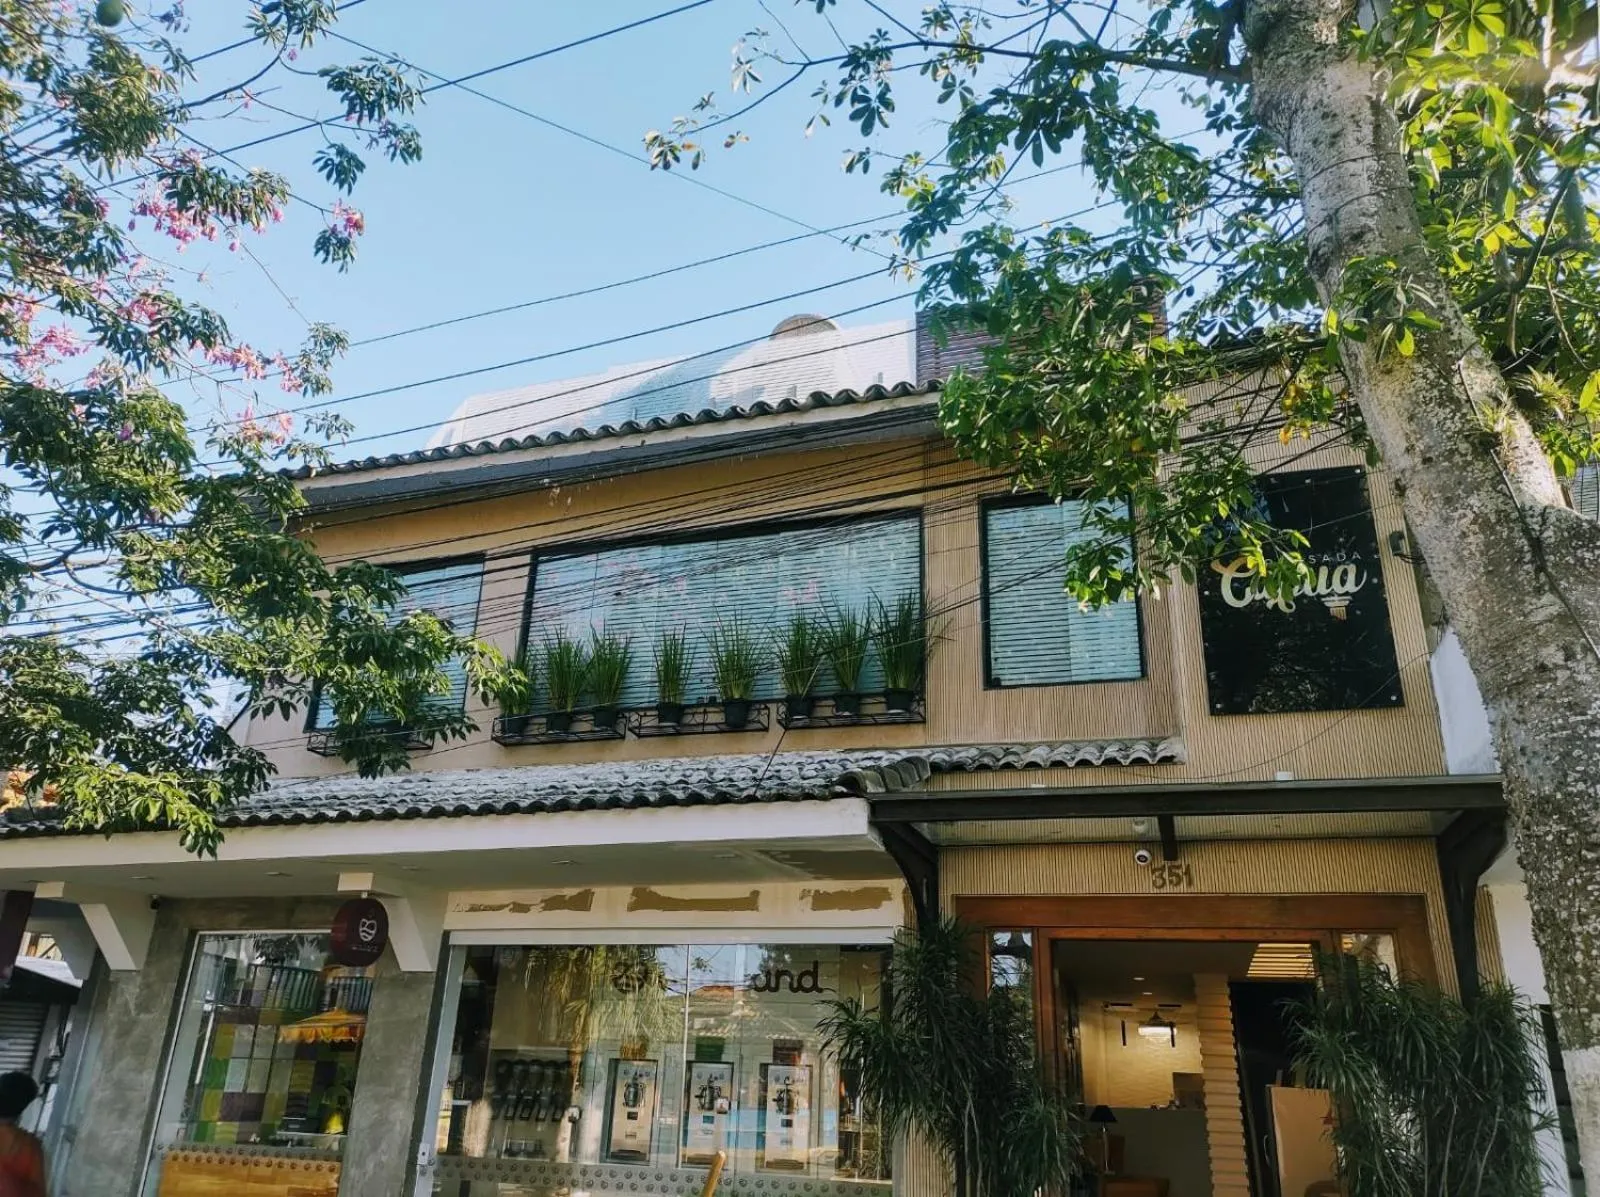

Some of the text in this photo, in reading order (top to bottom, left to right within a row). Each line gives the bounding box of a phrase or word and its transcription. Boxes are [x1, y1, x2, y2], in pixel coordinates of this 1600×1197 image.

[1265, 551, 1361, 569] SADA
[1210, 556, 1368, 613] Cua
[1151, 864, 1193, 889] 351
